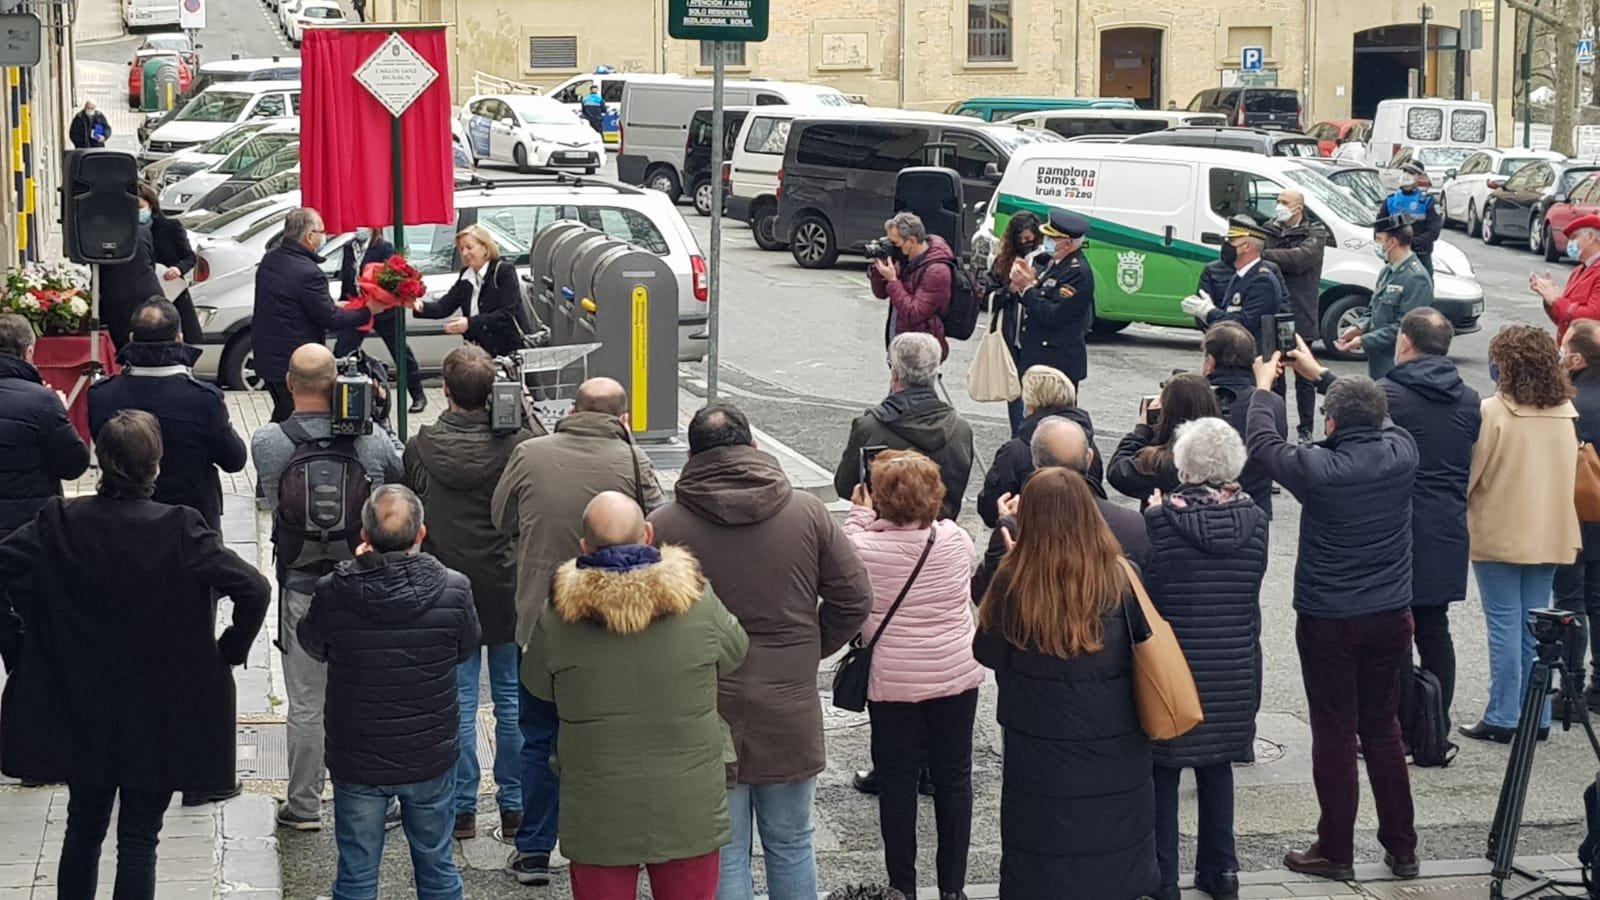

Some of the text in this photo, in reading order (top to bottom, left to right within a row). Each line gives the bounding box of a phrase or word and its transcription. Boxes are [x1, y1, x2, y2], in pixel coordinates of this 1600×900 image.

[688, 8, 707, 17] SOLO
[1246, 50, 1259, 68] P
[1037, 166, 1096, 178] pamplona
